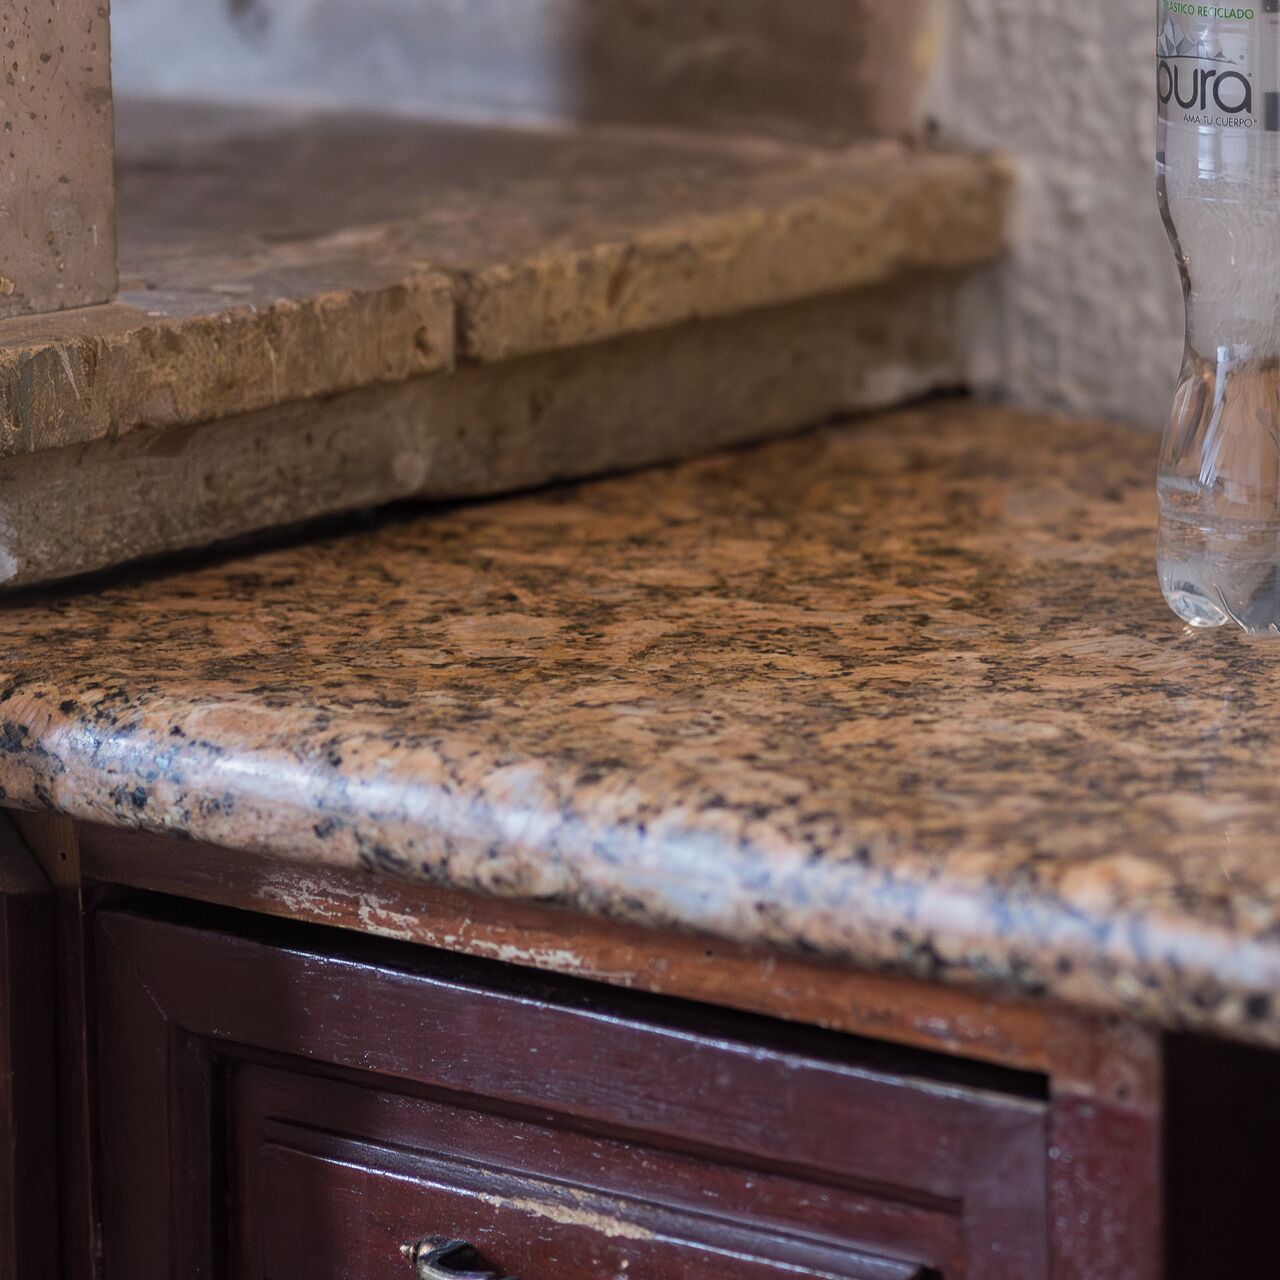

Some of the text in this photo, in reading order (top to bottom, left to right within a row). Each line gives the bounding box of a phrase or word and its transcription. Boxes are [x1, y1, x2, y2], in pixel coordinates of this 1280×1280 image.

[1197, 5, 1254, 20] RECICLADO
[1157, 60, 1252, 114] pura
[1183, 114, 1253, 129] AMA TU CUERPO
